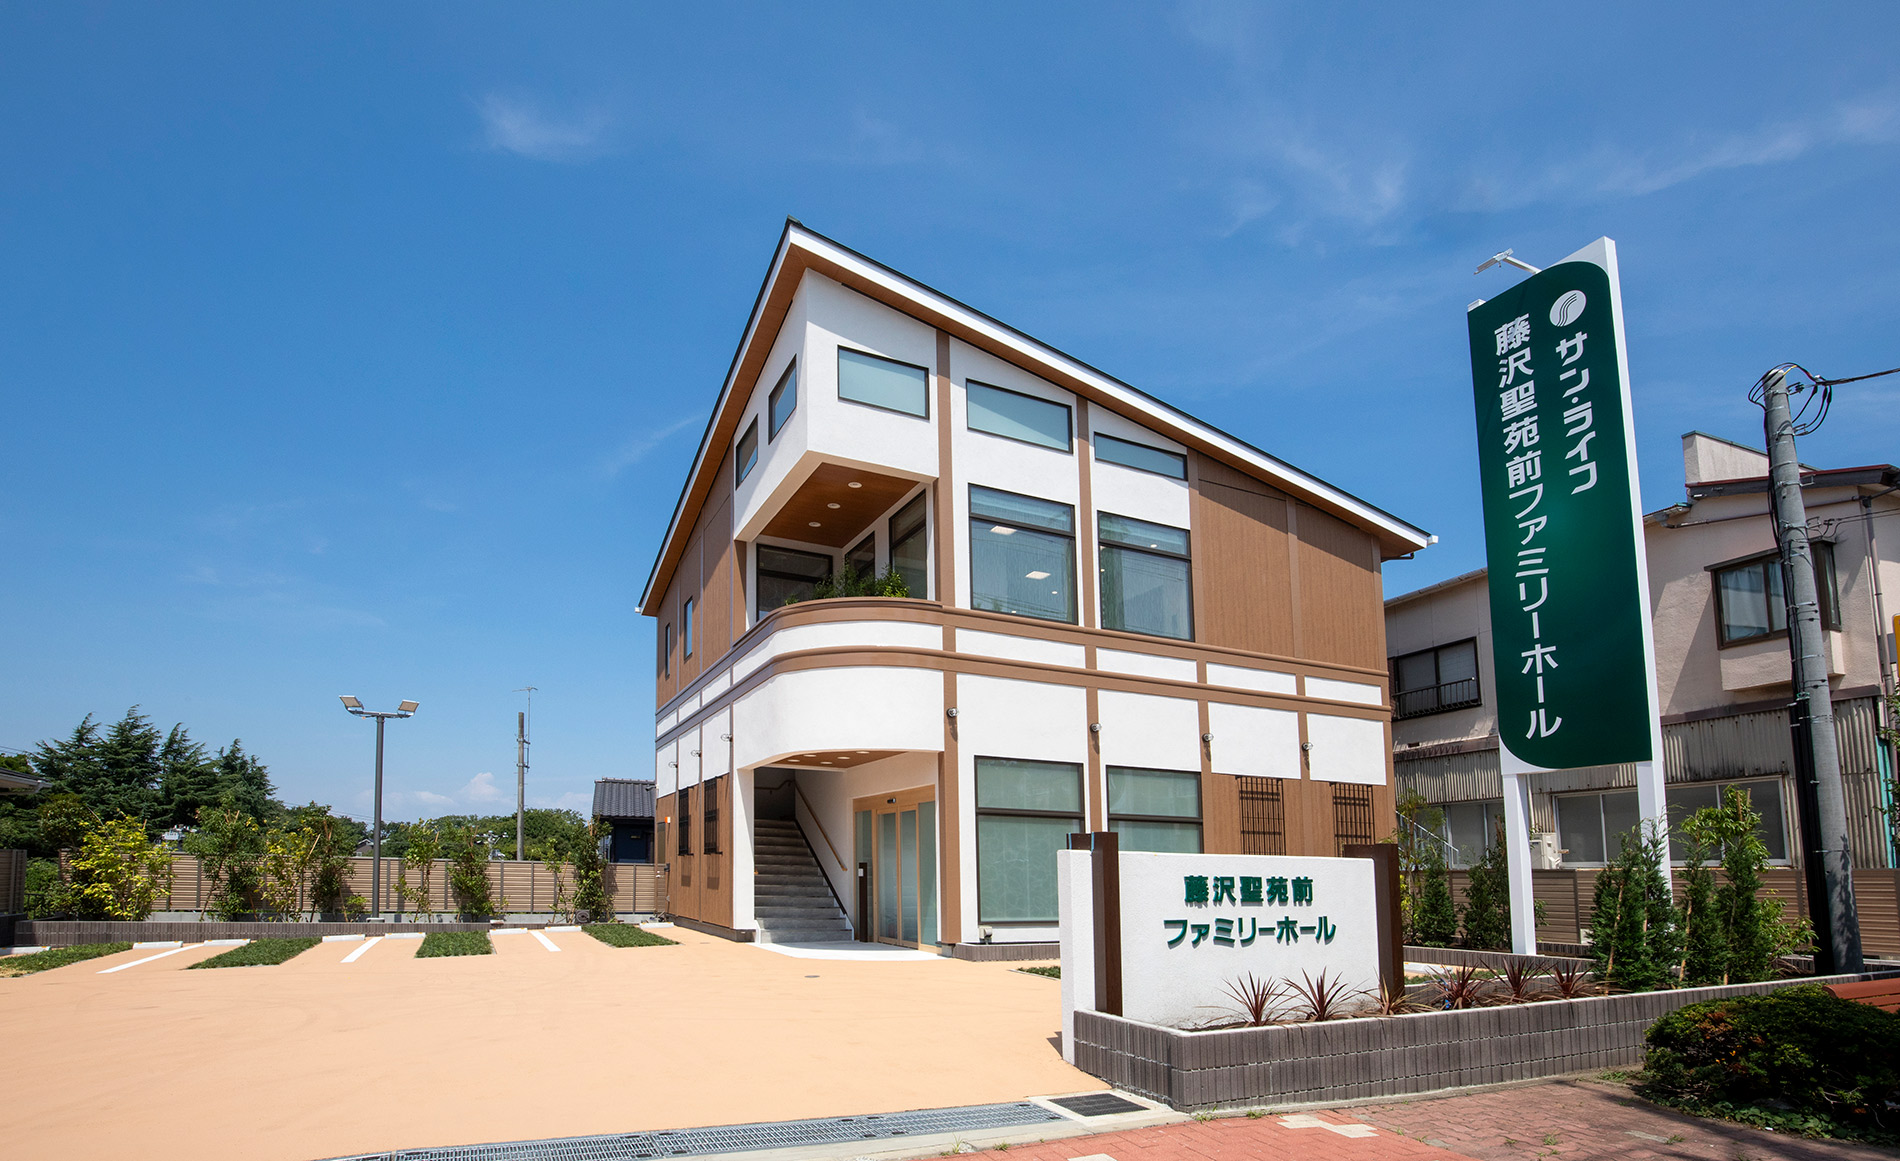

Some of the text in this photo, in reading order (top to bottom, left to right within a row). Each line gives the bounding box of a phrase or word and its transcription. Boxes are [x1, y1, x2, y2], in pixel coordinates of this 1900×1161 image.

[1494, 313, 1562, 740] 藤沢聖苑前ファミリーホール
[1184, 875, 1313, 903] 藤沢聖苑前
[1163, 916, 1337, 945] ファミリーホール
